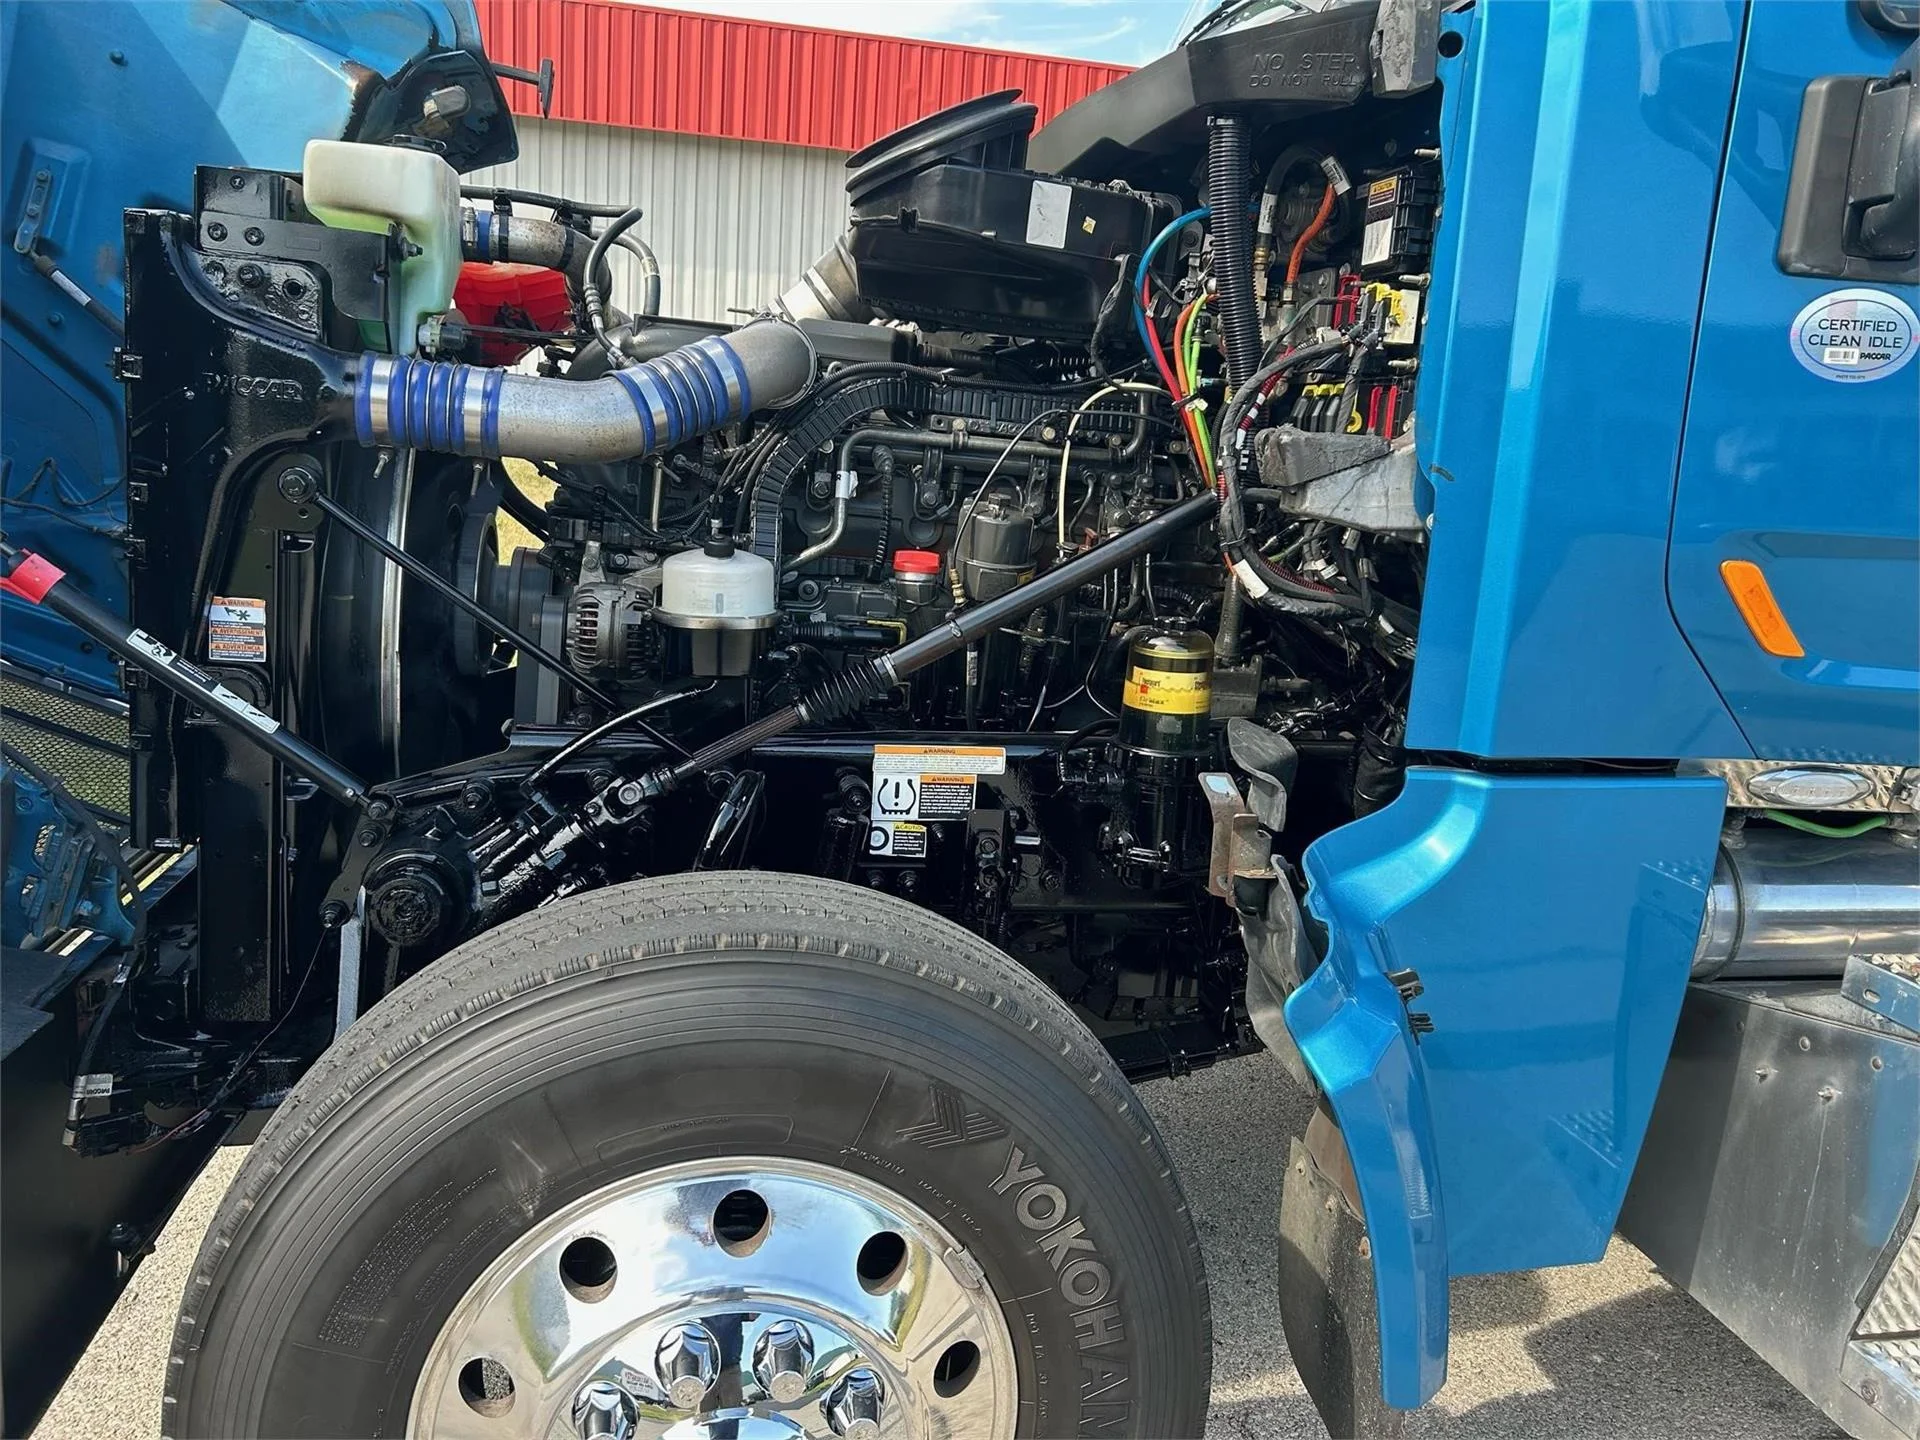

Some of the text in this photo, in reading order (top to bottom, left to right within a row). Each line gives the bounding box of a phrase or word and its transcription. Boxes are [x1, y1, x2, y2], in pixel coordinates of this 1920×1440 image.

[1253, 53, 1356, 72] NO STEP
[1249, 74, 1357, 87] DO NOT PULL
[1818, 318, 1897, 332] CERTIFIED
[1808, 334, 1903, 348] CLEAN IDLE
[1859, 352, 1891, 360] PACCAR
